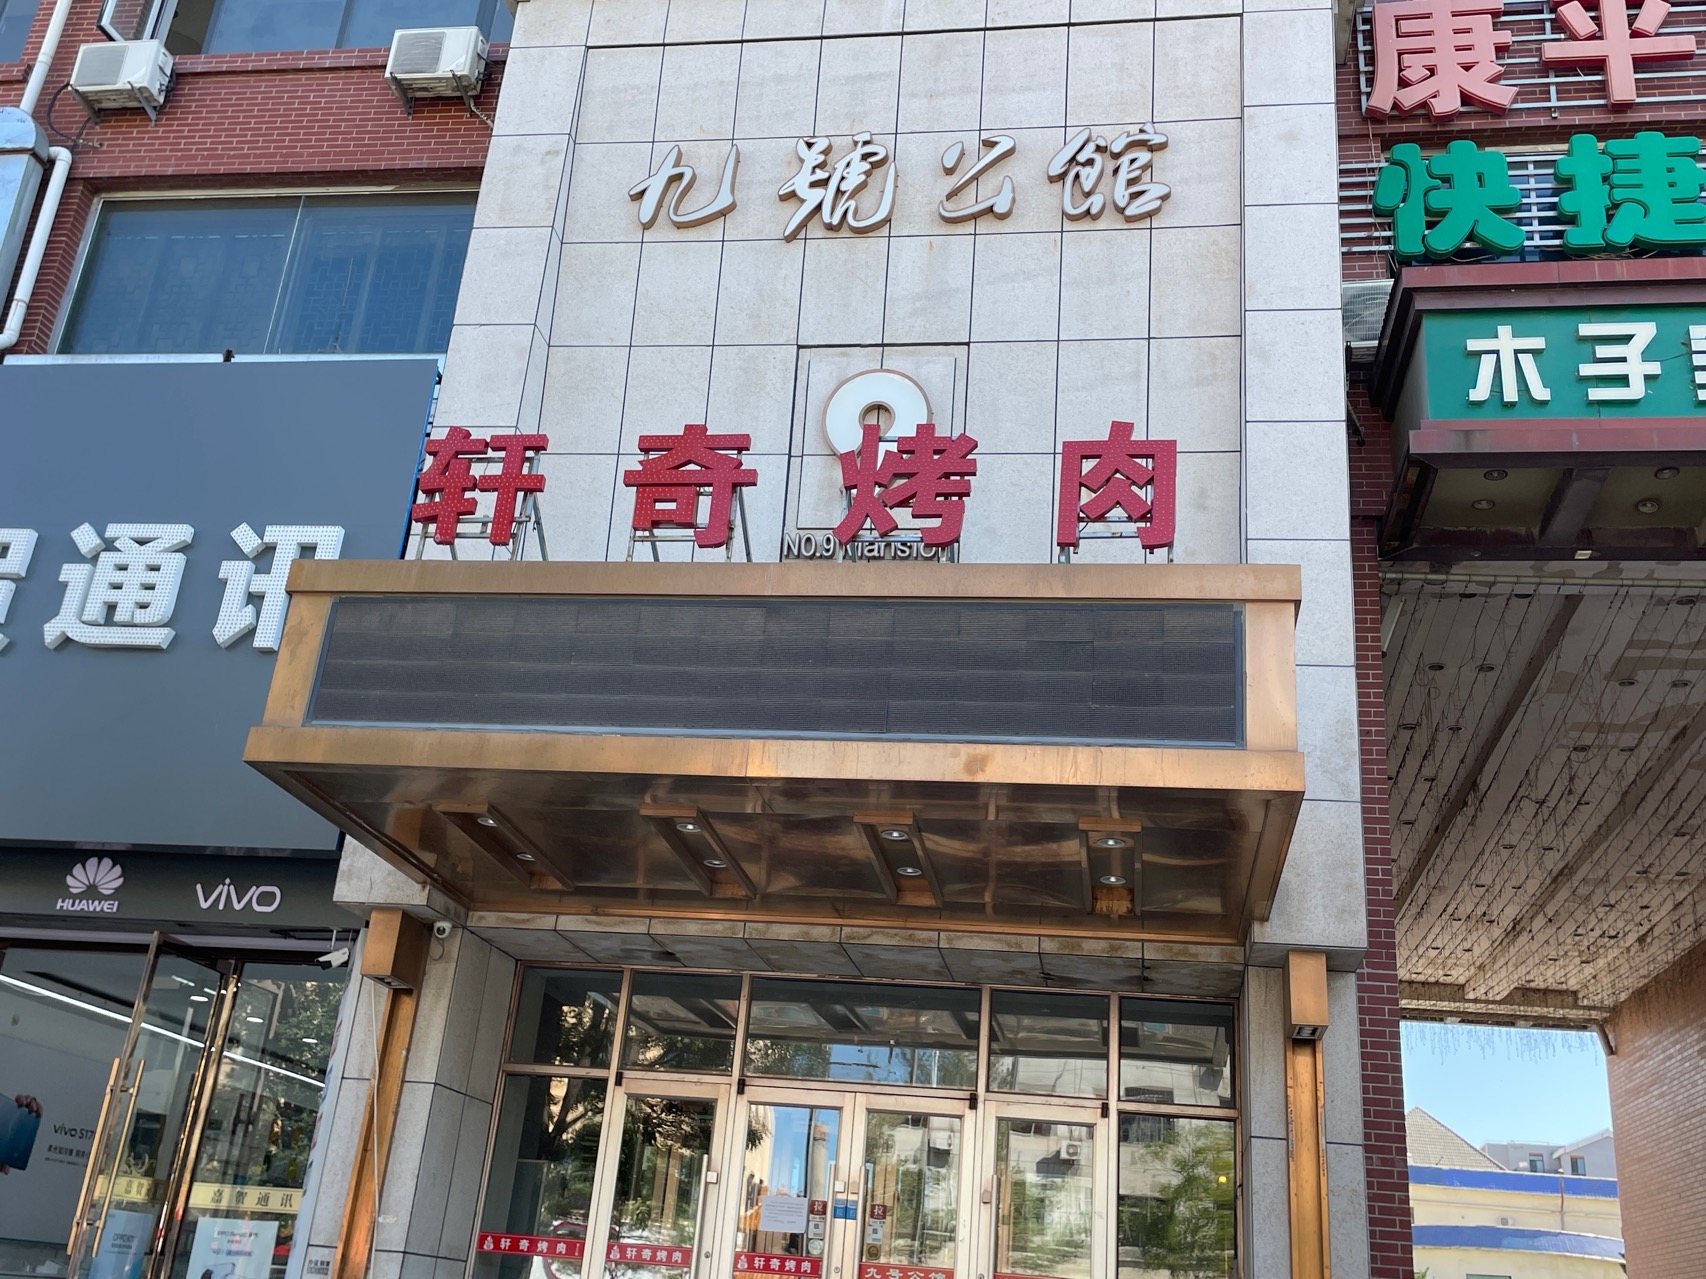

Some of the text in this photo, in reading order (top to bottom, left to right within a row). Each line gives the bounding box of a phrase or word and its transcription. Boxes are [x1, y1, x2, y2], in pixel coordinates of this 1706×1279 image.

[1372, 131, 1706, 262] 快捷
[1466, 320, 1706, 406] 木子
[412, 420, 1178, 551] 轩奇烤肉
[196, 877, 282, 912] vivo
[56, 898, 119, 912] HUAWEI
[53, 1123, 77, 1138] vivo
[210, 1188, 293, 1208] 嘉贺通讯
[500, 1237, 567, 1254] 轩奇烤肉
[626, 1247, 682, 1263] 轩奇烤肉
[753, 1257, 811, 1274] 轩奇烤肉
